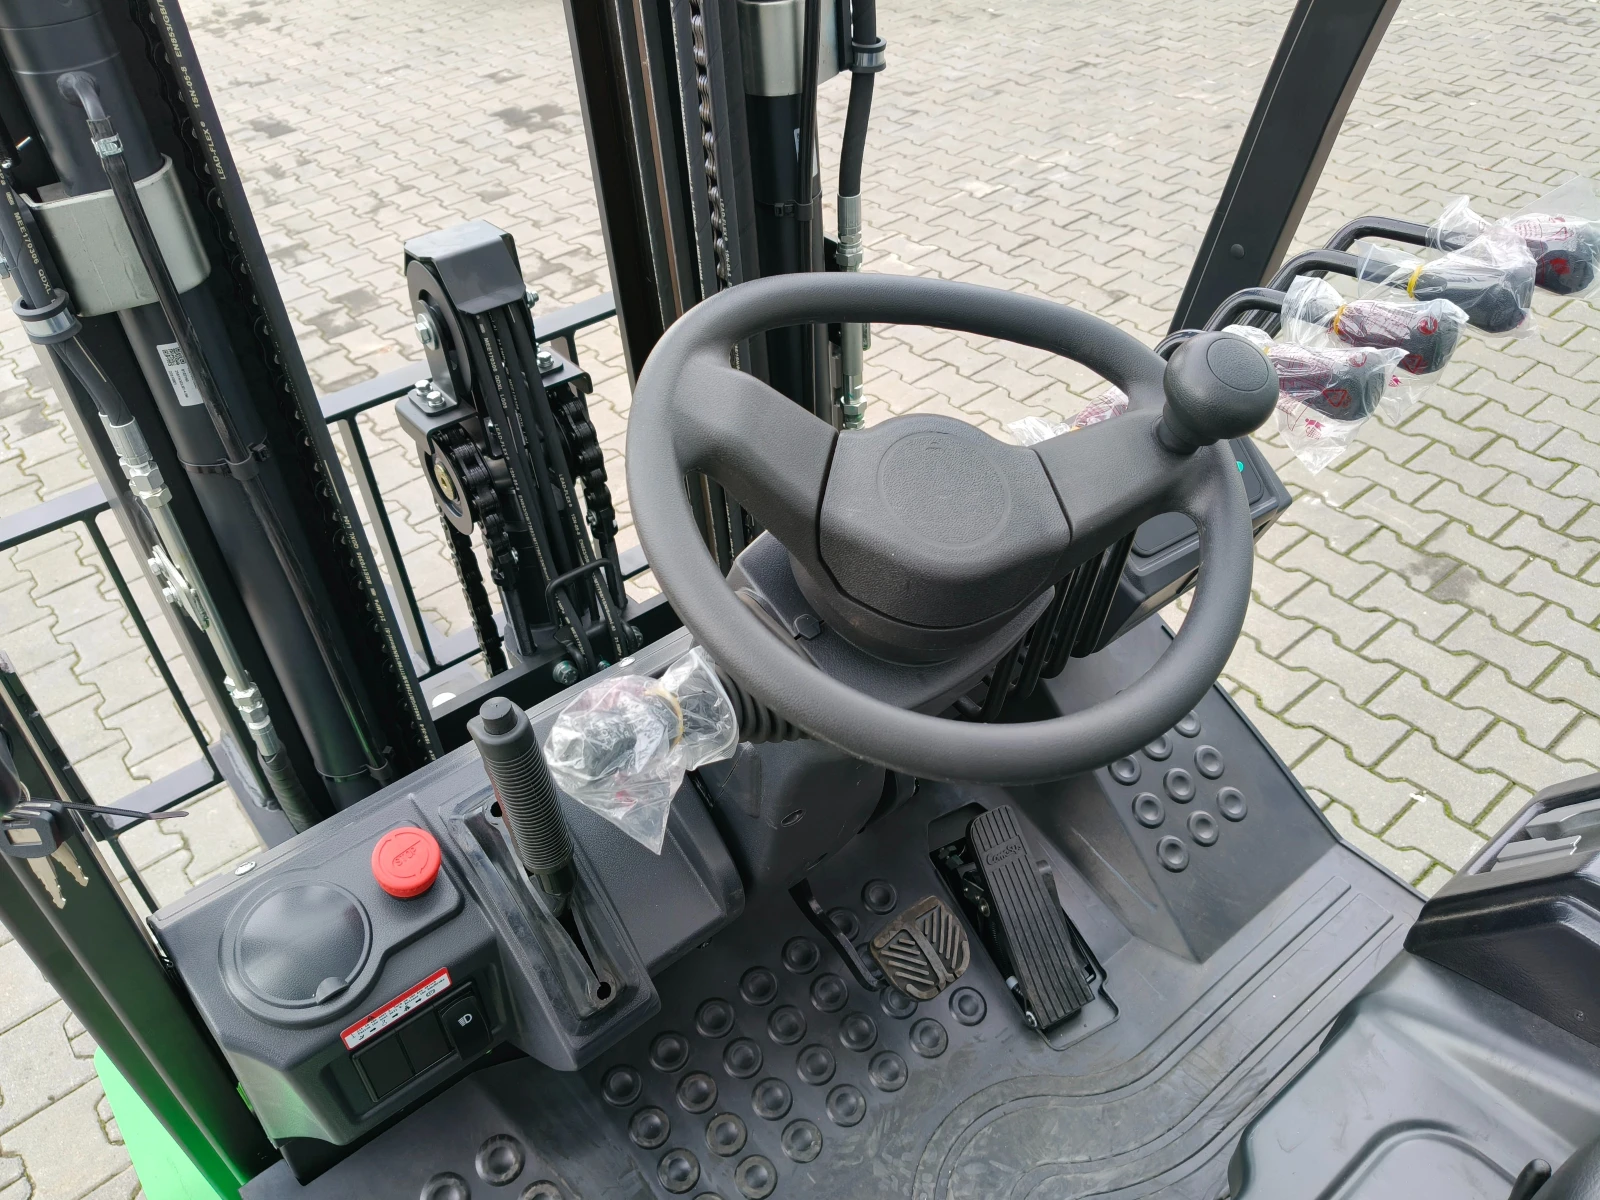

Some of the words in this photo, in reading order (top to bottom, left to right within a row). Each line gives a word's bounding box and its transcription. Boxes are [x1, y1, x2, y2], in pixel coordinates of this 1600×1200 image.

[181, 65, 201, 109] 1SN-05-8
[13, 211, 40, 265] MEE170306
[38, 268, 52, 294] QDXL
[393, 846, 418, 867] STOP
